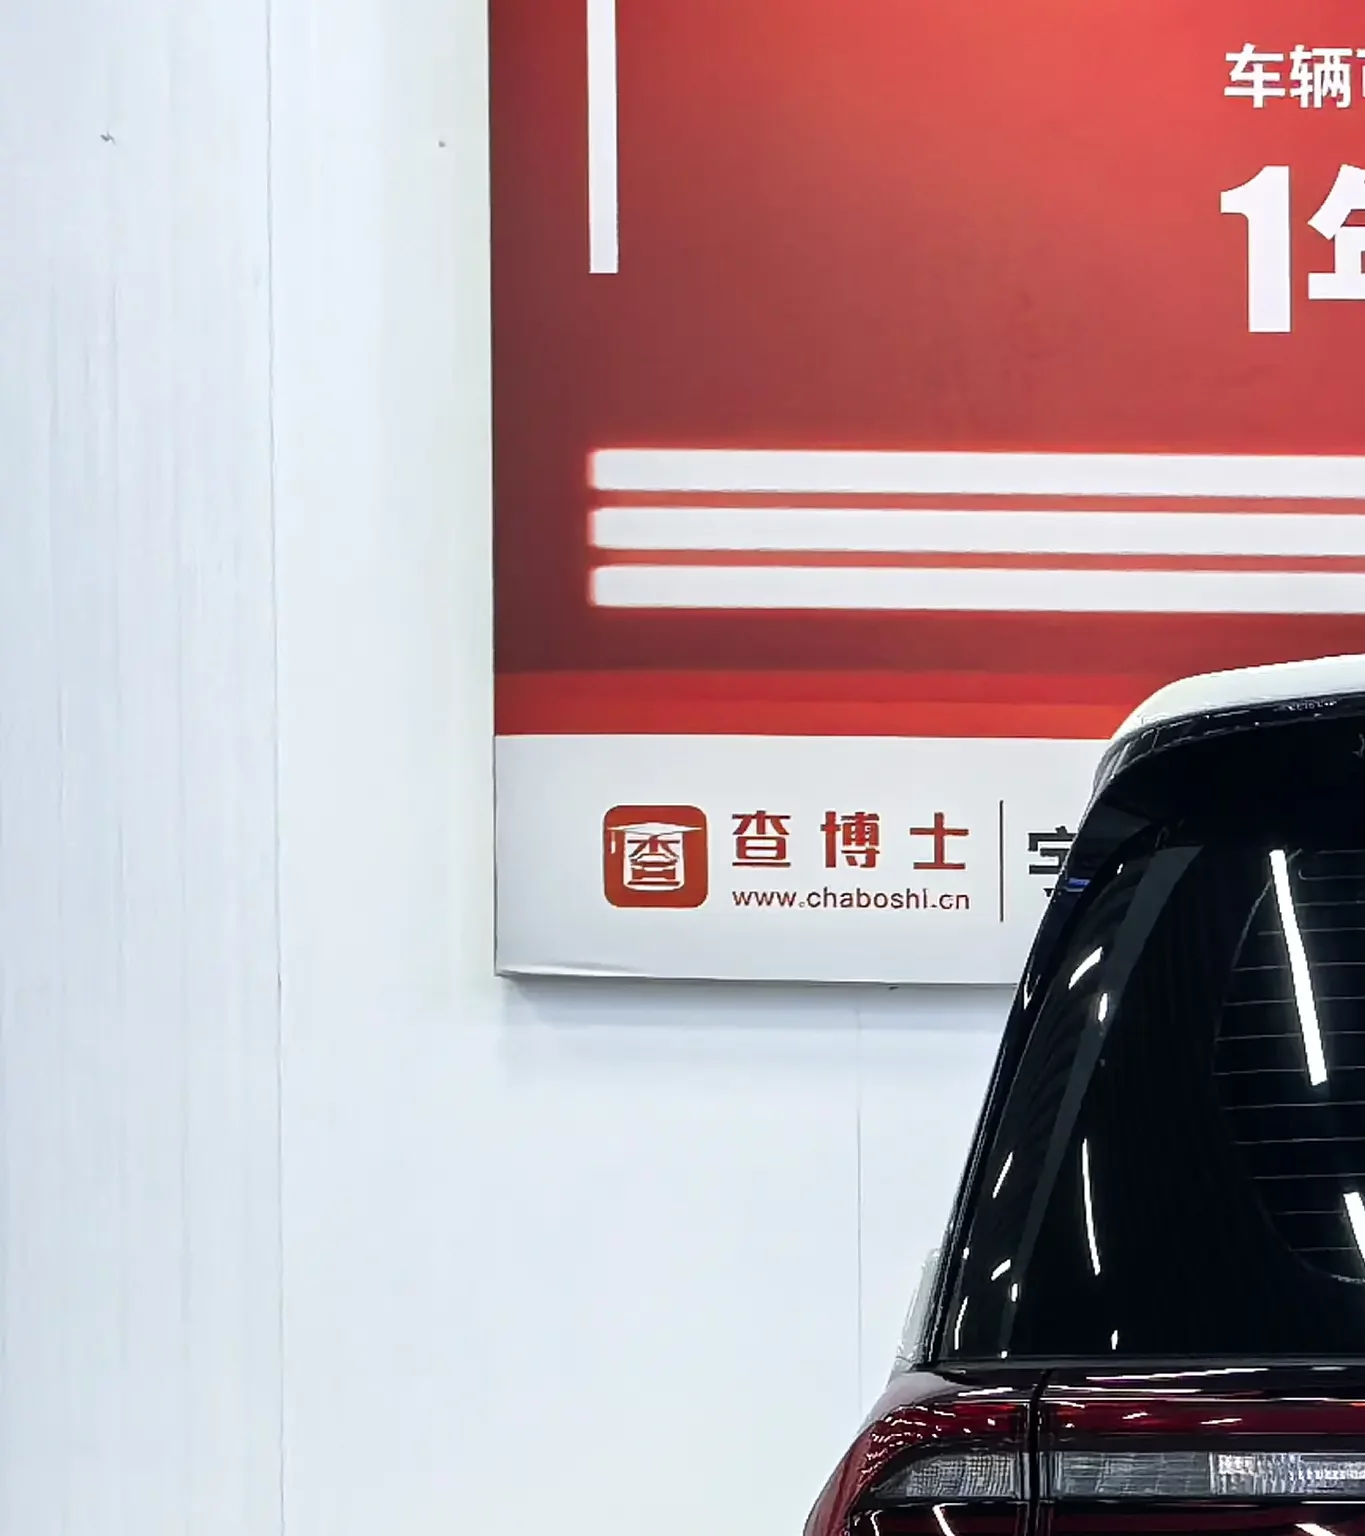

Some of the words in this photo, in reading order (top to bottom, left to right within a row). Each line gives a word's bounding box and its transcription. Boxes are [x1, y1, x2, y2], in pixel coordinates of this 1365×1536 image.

[731, 810, 970, 870] 查博士
[731, 886, 971, 911] www.chaboshi.cn
